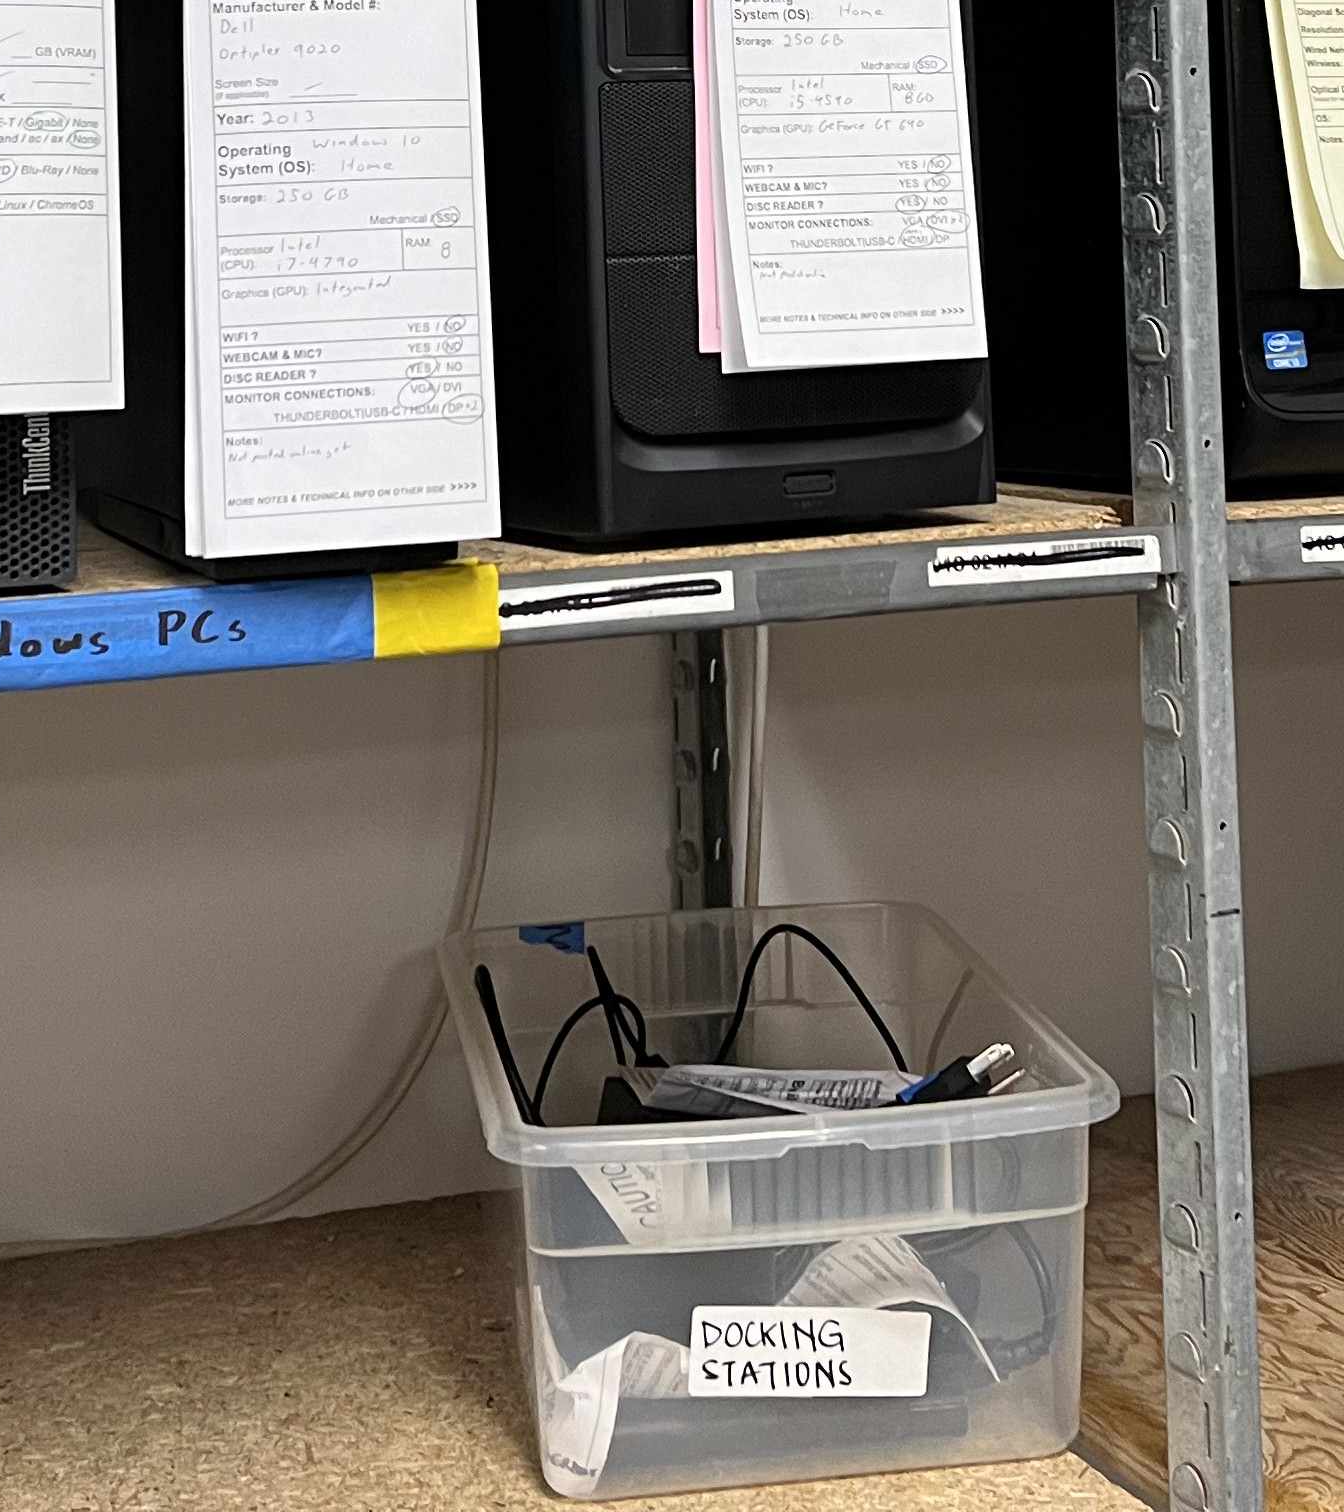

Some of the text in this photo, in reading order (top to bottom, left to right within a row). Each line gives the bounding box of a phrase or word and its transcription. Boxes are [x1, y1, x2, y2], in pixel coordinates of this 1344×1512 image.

[220, 18, 254, 34] Dell
[294, 44, 341, 57] 9020
[217, 110, 314, 126] Year: 2013
[156, 610, 249, 649] PCs
[701, 1319, 845, 1350] DOCKING
[701, 1359, 853, 1390] STATIONS
